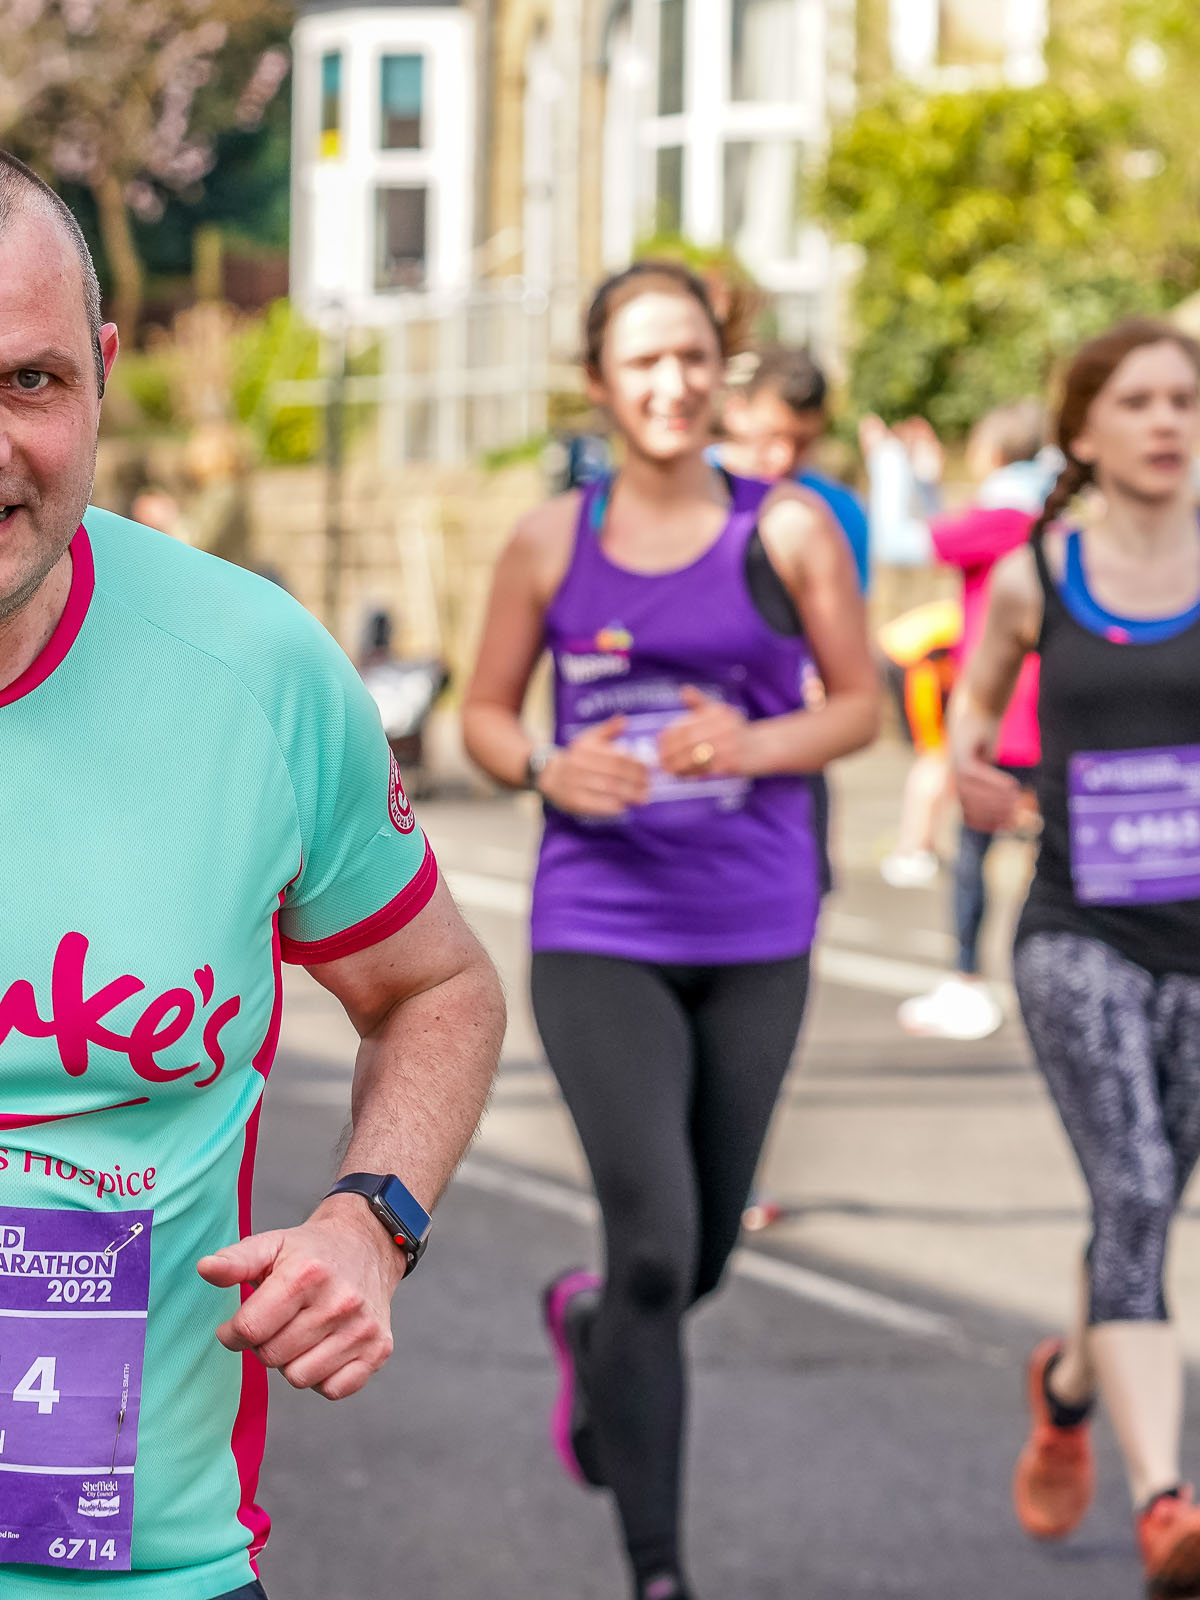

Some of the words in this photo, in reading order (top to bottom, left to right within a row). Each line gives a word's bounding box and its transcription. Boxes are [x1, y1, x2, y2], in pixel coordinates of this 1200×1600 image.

[23, 1150, 157, 1199] Hospice
[46, 1279, 113, 1303] 2022
[81, 1480, 119, 1492] Sheffield
[7, 1531, 20, 1539] line
[48, 1537, 117, 1561] 6714
